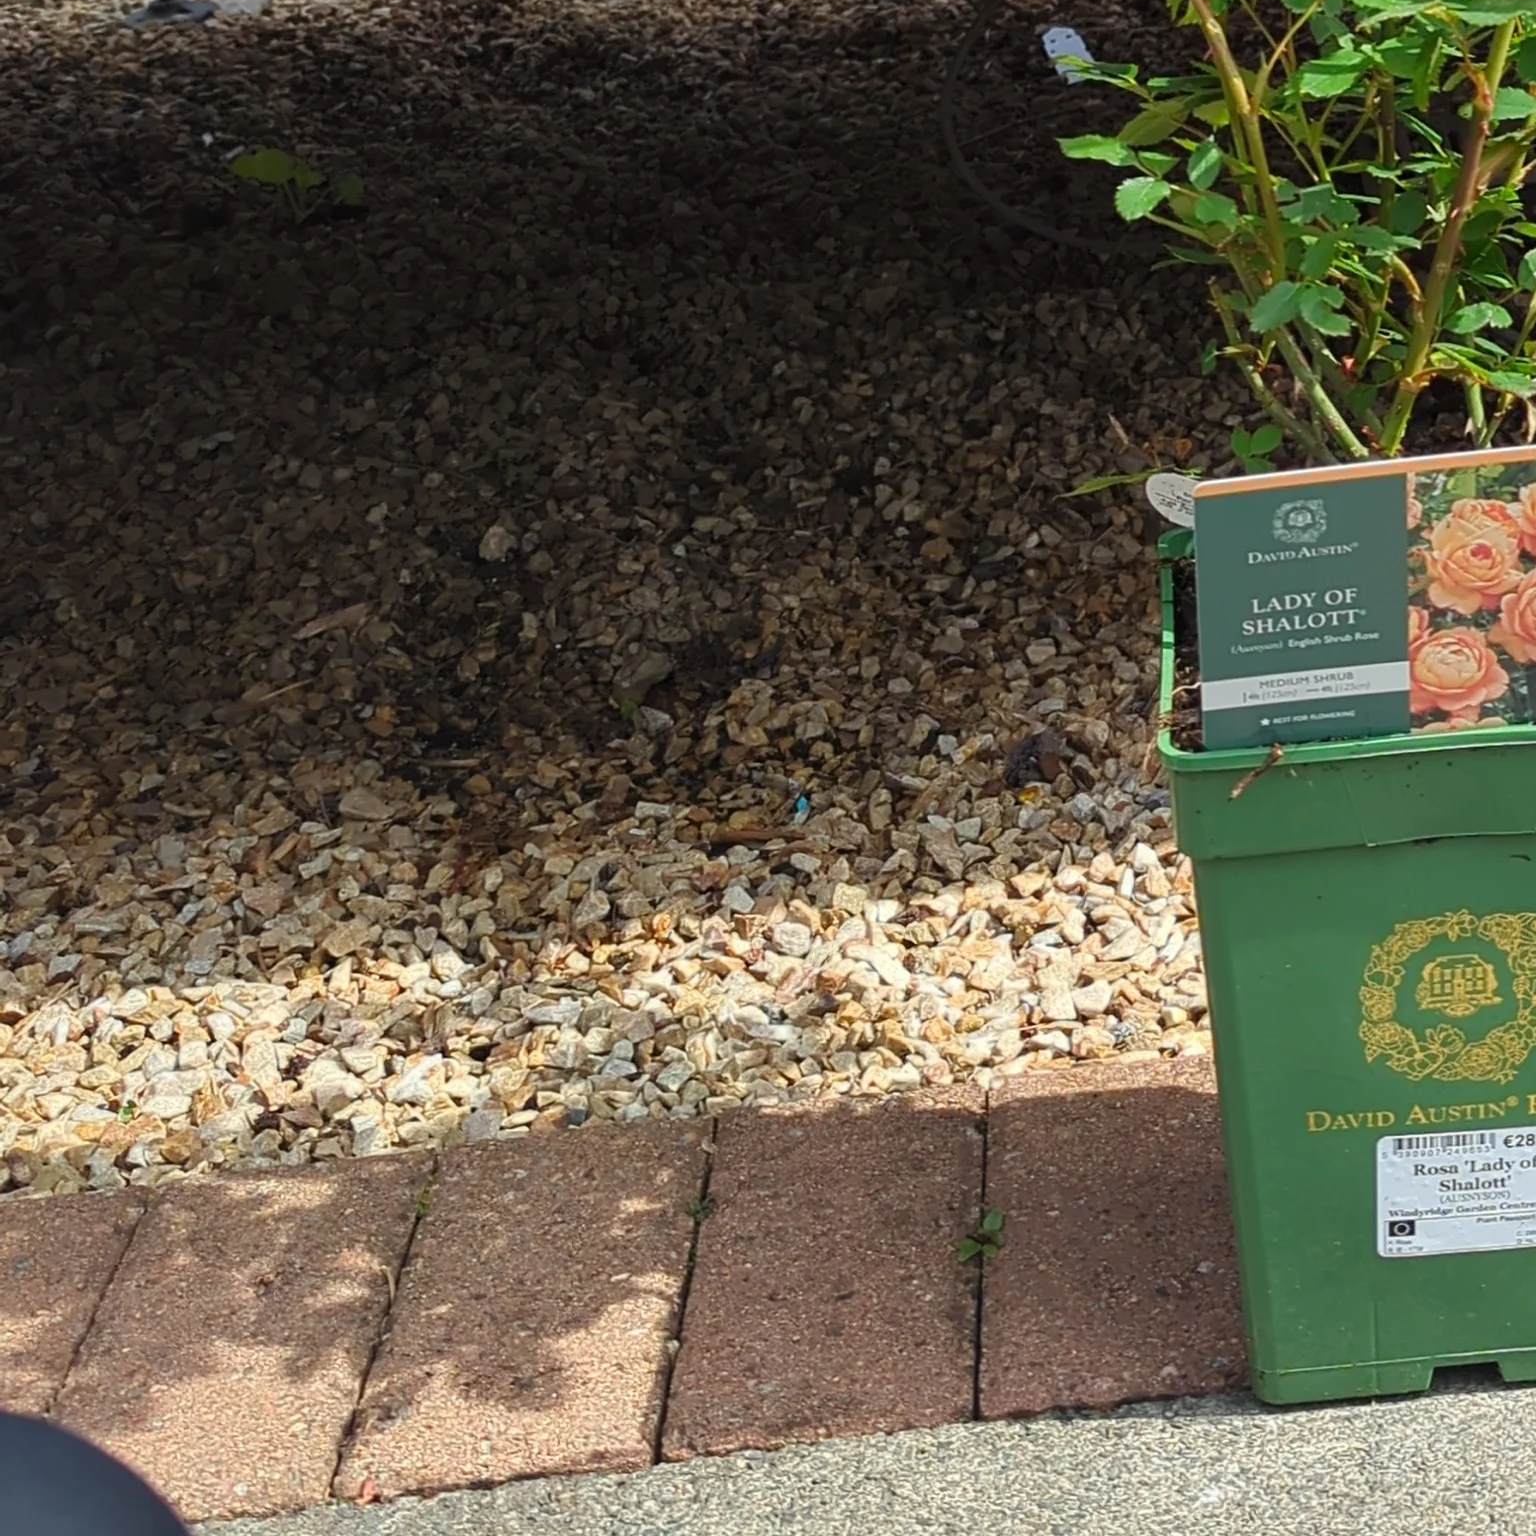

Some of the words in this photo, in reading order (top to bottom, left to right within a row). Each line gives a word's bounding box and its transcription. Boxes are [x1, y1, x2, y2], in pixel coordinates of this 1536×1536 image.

[1247, 550, 1296, 565] DAVID
[1252, 592, 1317, 614] LADY
[1324, 588, 1358, 605] OF
[1288, 636, 1321, 648] English
[1323, 634, 1353, 644] Shrub
[1355, 632, 1379, 641] Rose
[1259, 676, 1309, 689] MEDIUM
[1313, 672, 1354, 684] SHRUB
[1307, 1110, 1395, 1131] DAVID
[1413, 1163, 1459, 1177] Rosa
[1465, 1159, 1515, 1173] 'Lady
[1438, 1175, 1512, 1193] Shalott'
[1388, 1206, 1454, 1219] Windyridge
[1456, 1203, 1497, 1214] Garden
[1500, 1201, 1536, 1211] Centre
